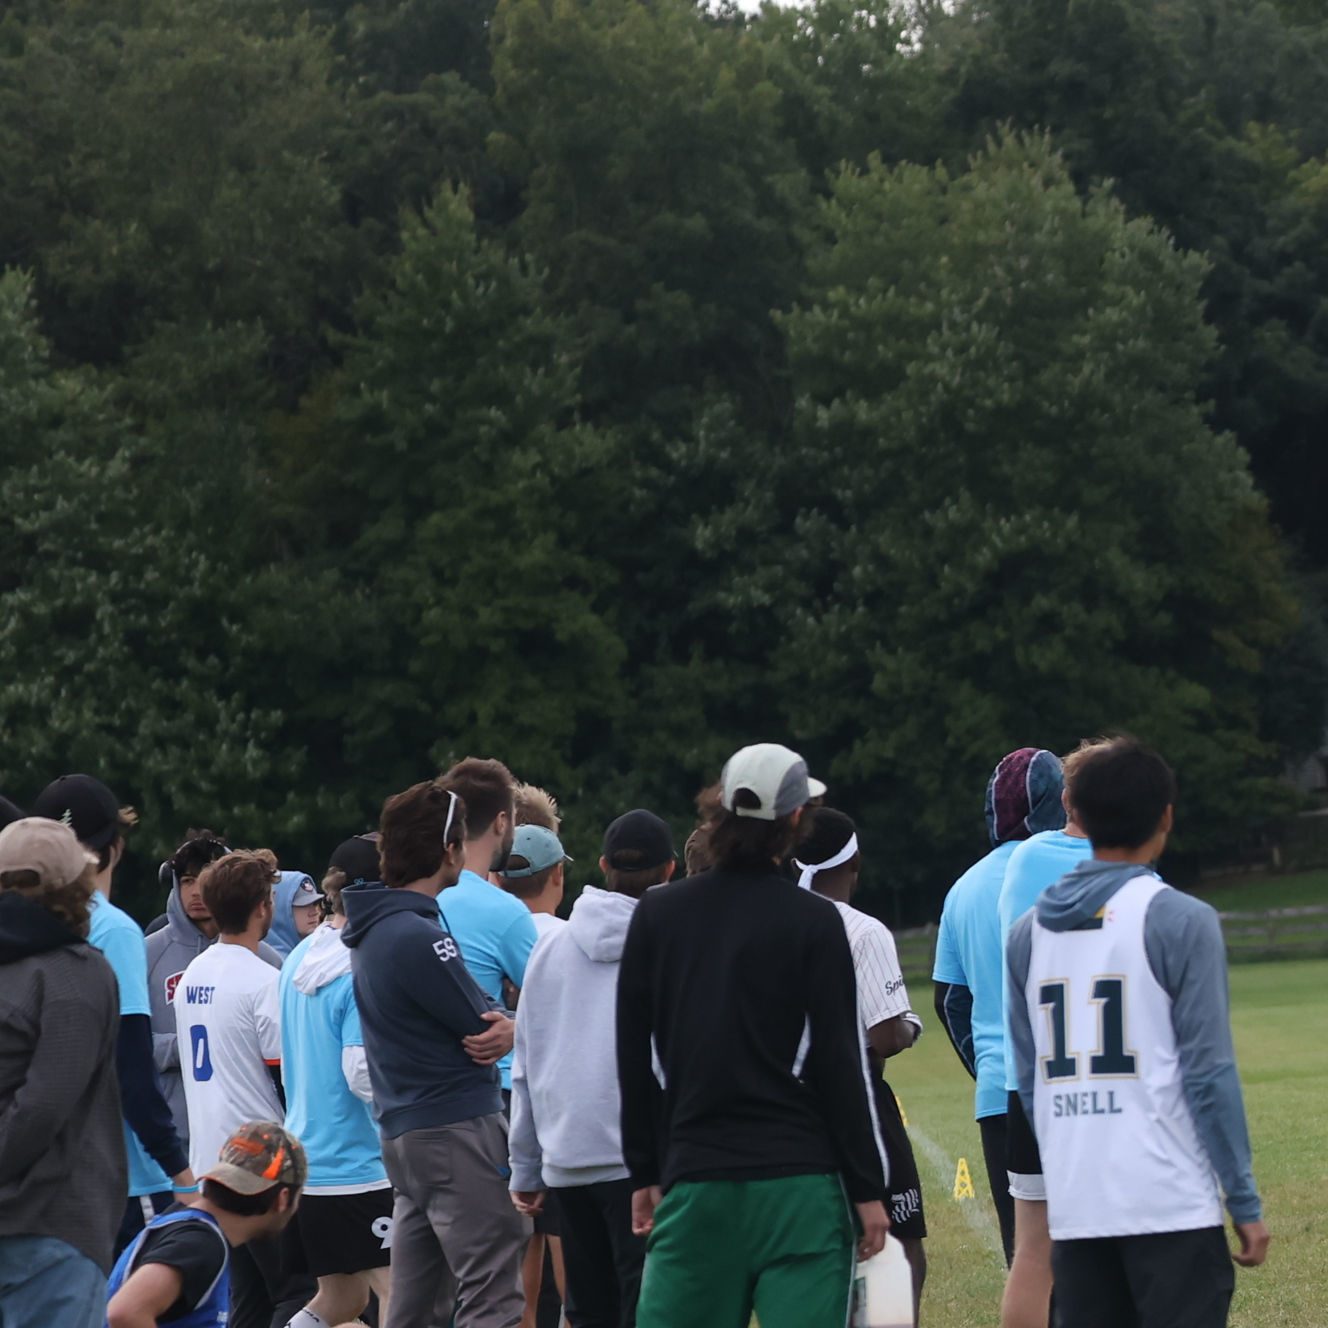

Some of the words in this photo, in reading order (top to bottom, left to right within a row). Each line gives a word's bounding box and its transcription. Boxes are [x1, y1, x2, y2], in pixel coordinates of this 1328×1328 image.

[432, 937, 457, 962] 59
[186, 986, 215, 1005] WEST
[1038, 973, 1140, 1085] 11
[190, 1024, 214, 1082] 0
[1053, 1091, 1123, 1118] SNELL
